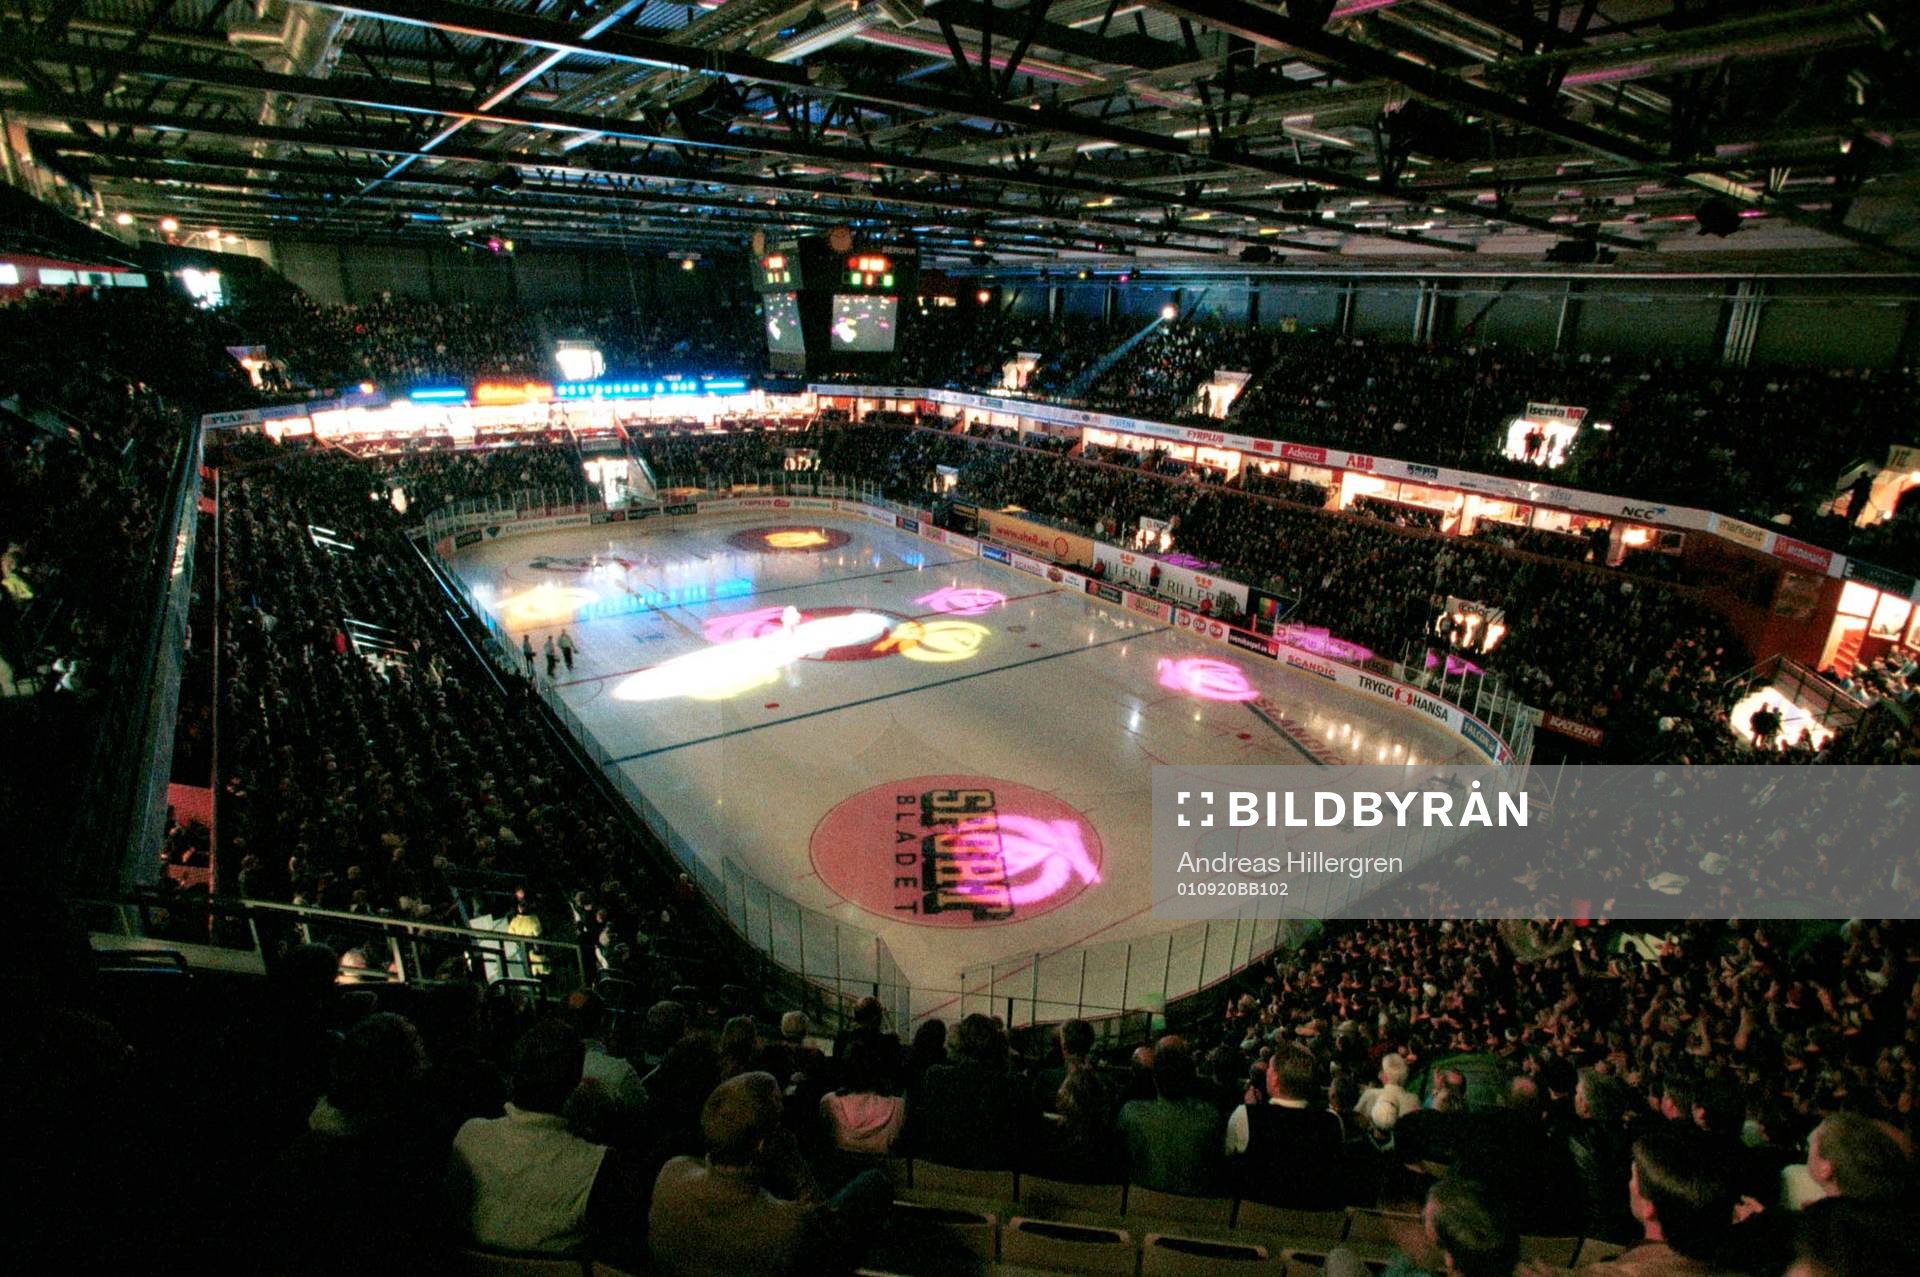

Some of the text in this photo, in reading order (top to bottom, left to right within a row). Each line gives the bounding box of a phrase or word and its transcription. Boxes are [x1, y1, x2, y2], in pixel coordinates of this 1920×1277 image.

[1528, 403, 1566, 417] isenta
[1187, 430, 1224, 444] FYRPLUS
[1287, 446, 1320, 462] Adecco
[1345, 455, 1374, 471] ABB
[1621, 505, 1654, 520] NCC
[1719, 519, 1764, 541] markant
[1287, 654, 1336, 677] SCANDIC
[1358, 674, 1449, 722] TRYGG HANSA
[1549, 714, 1601, 740] KATRIN
[894, 795, 918, 914] BLADET
